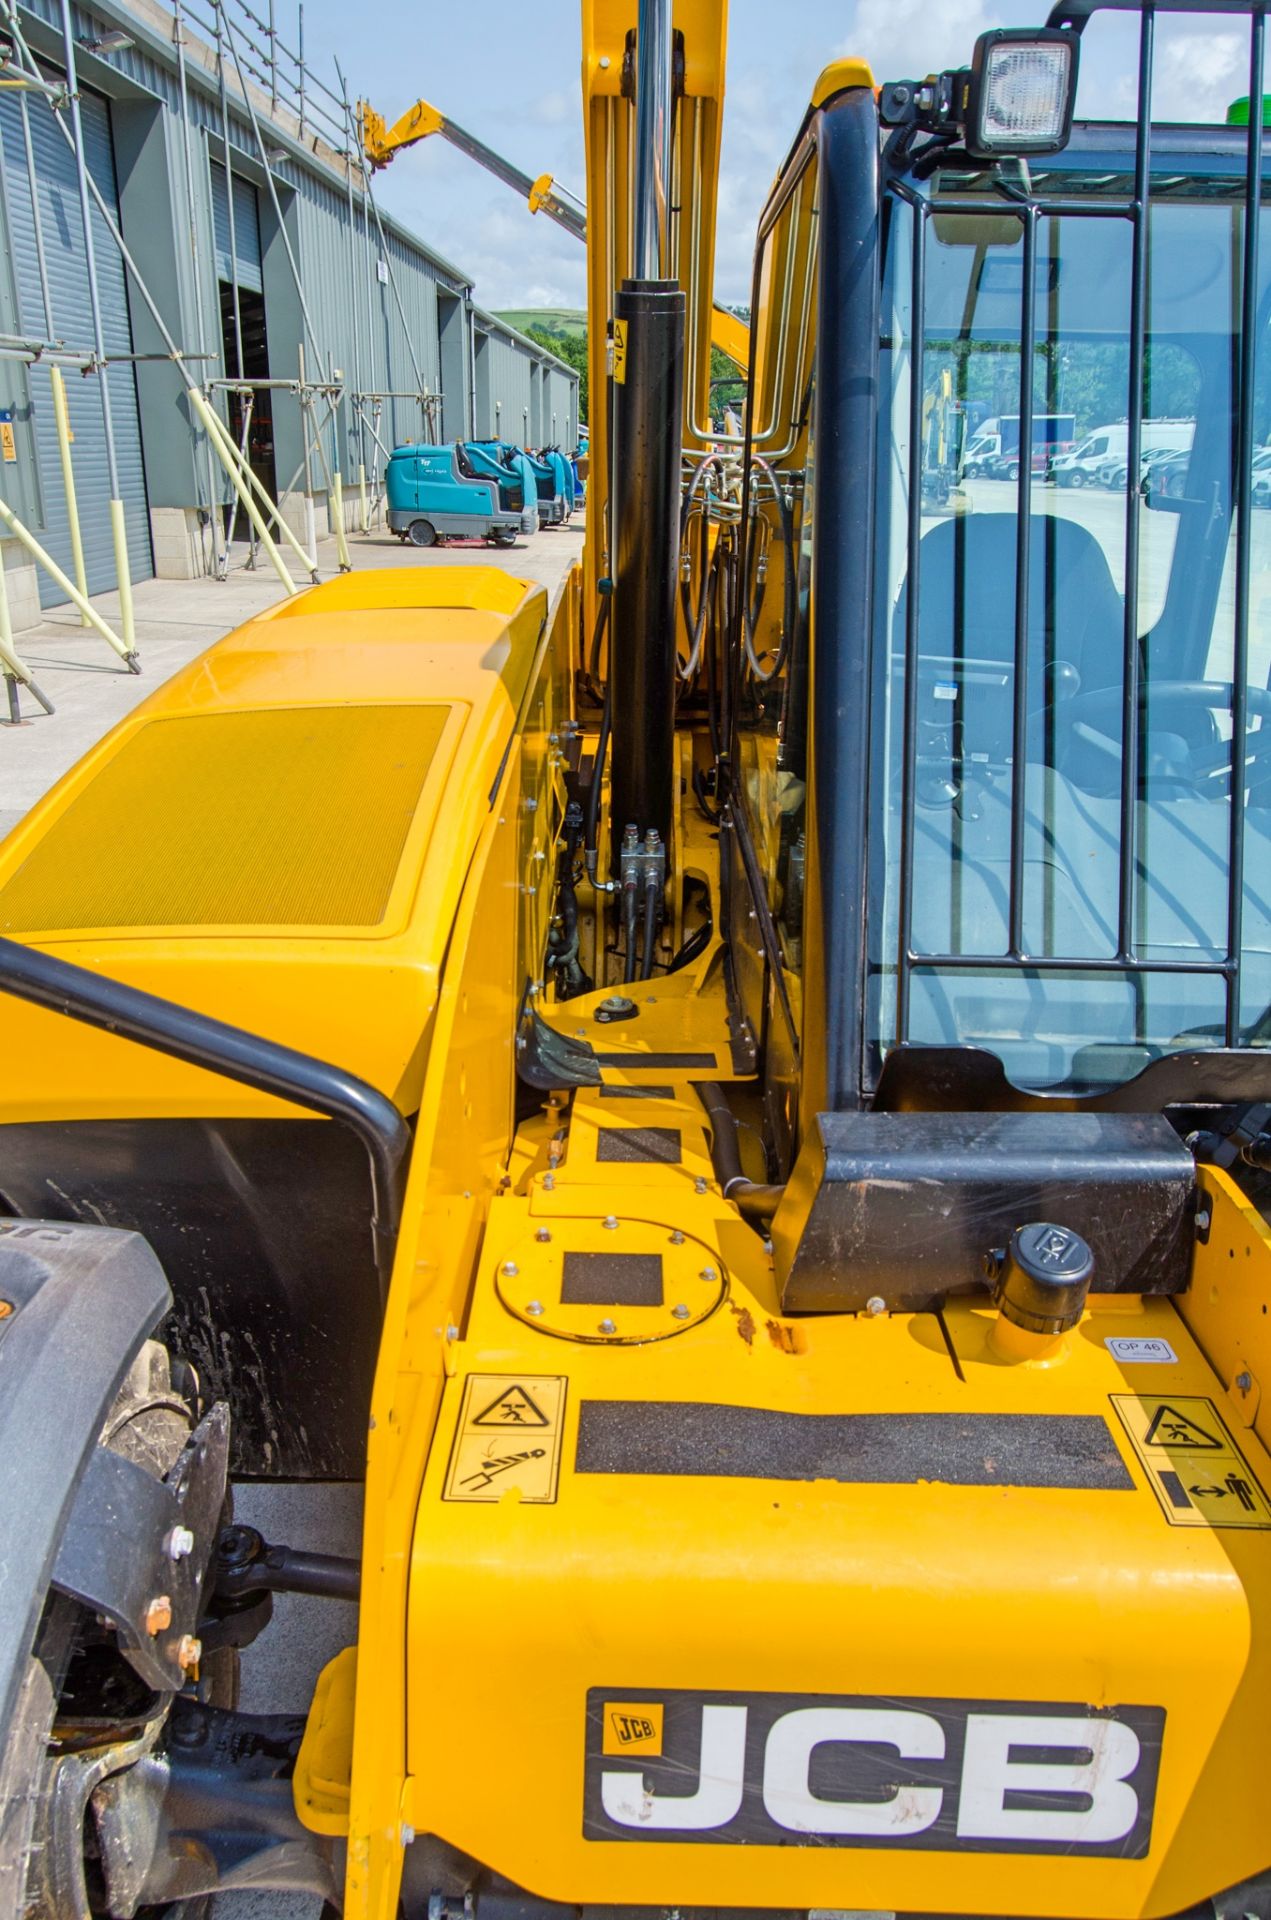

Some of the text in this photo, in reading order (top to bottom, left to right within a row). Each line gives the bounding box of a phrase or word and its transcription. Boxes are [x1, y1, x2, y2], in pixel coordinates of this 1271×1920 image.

[1118, 1342, 1161, 1352] OP 46
[619, 1717, 652, 1741] JCB
[602, 1705, 1141, 1842] JCB
